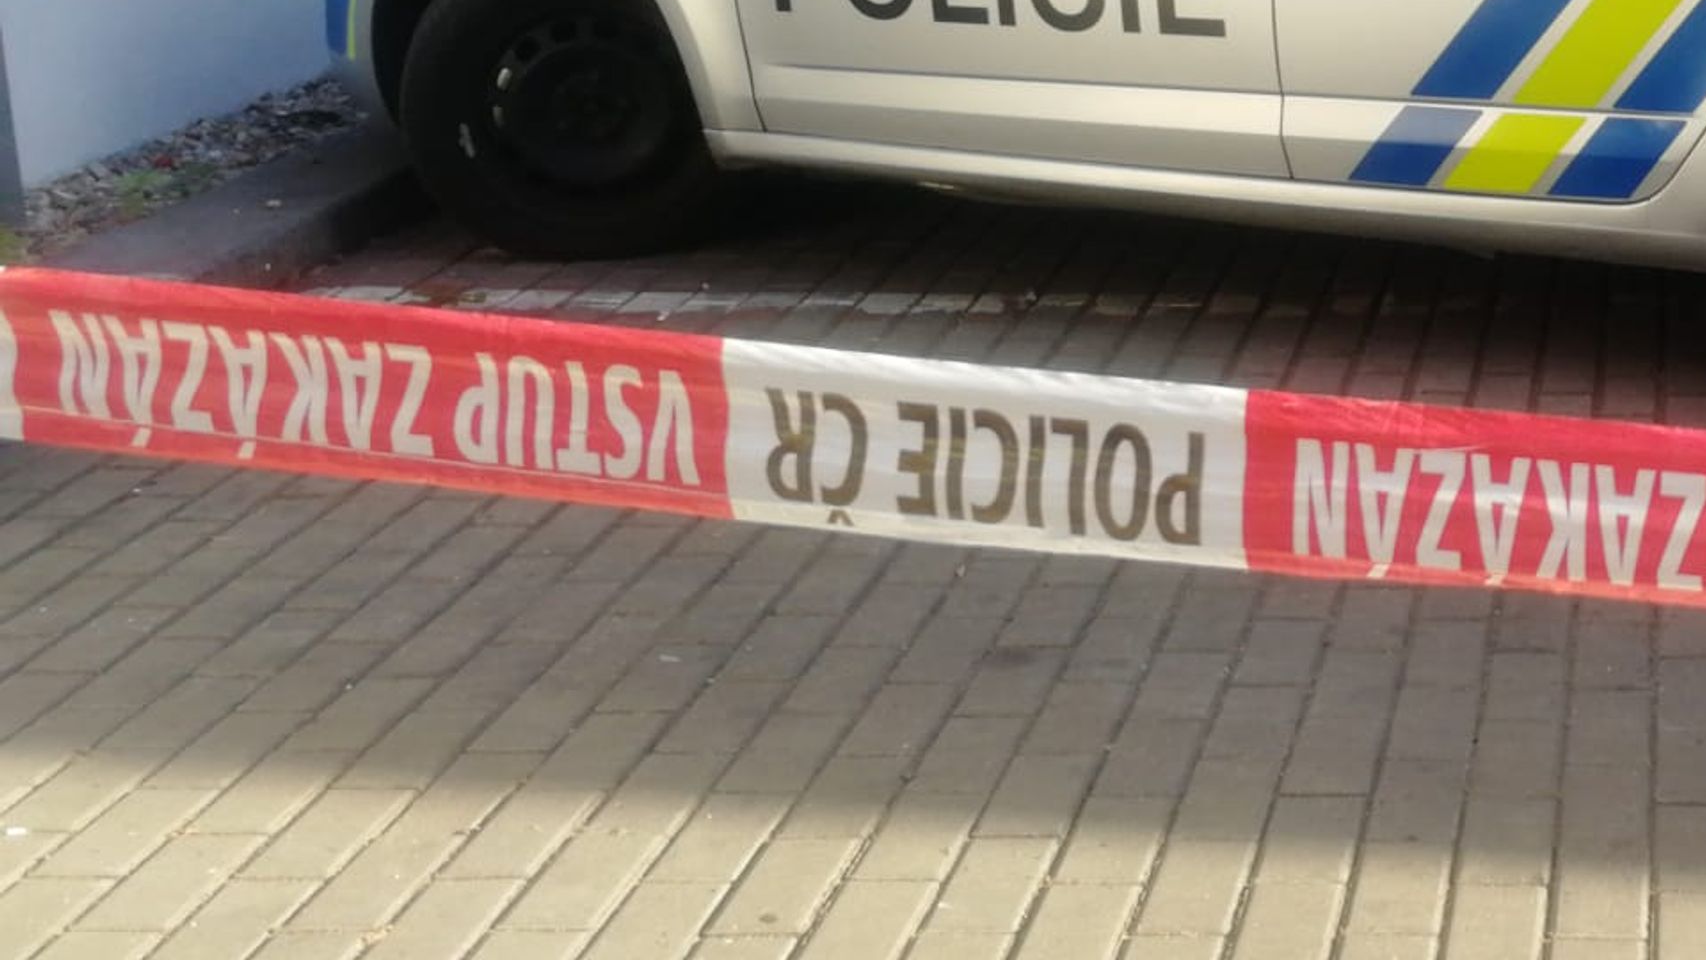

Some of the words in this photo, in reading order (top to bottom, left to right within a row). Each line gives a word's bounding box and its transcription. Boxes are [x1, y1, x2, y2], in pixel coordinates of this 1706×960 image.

[49, 307, 434, 460] ZAKÁZÁN
[453, 349, 702, 487] VSTUP
[764, 384, 868, 527] ČR
[895, 401, 1207, 546] POLICIE
